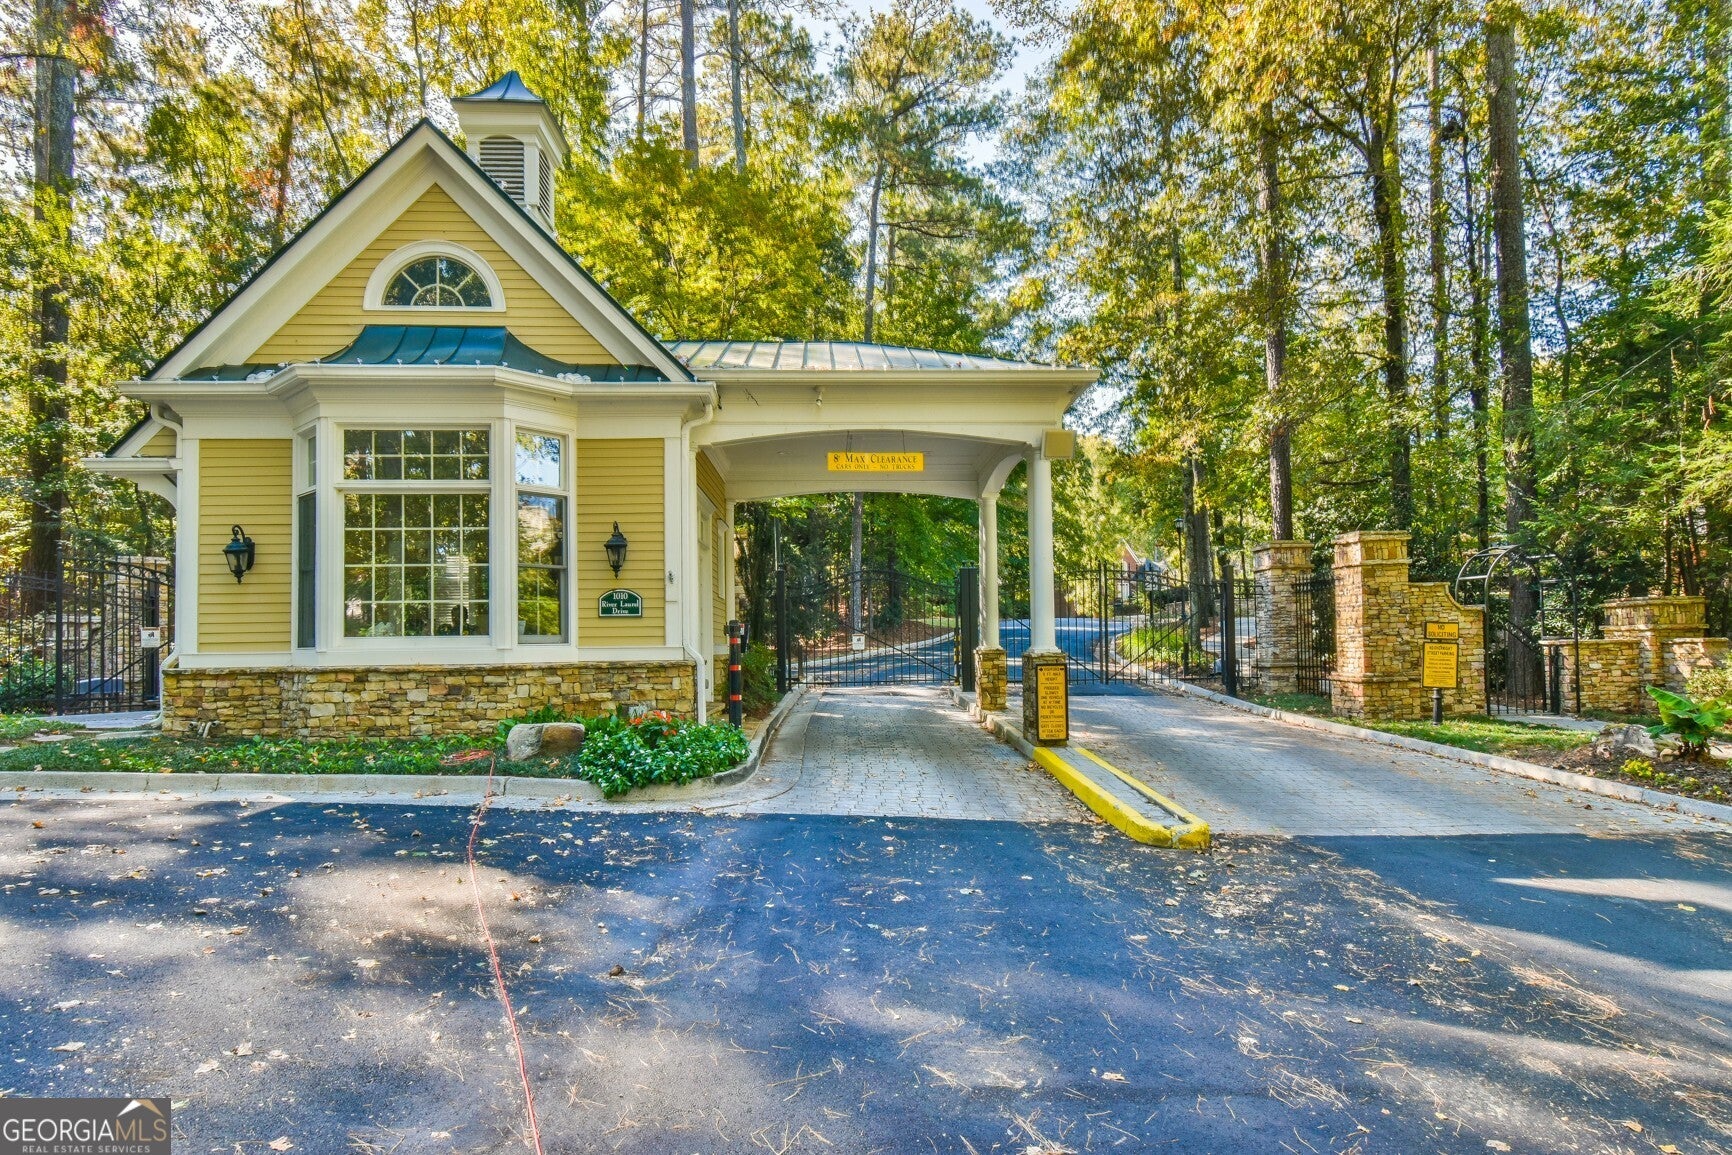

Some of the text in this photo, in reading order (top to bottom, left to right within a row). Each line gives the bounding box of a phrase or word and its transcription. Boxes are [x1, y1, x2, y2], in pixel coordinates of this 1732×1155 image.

[846, 453, 865, 463] MAX
[870, 453, 918, 463] CLEARANCE
[613, 592, 628, 600] 1010
[601, 599, 639, 608] River Laurel
